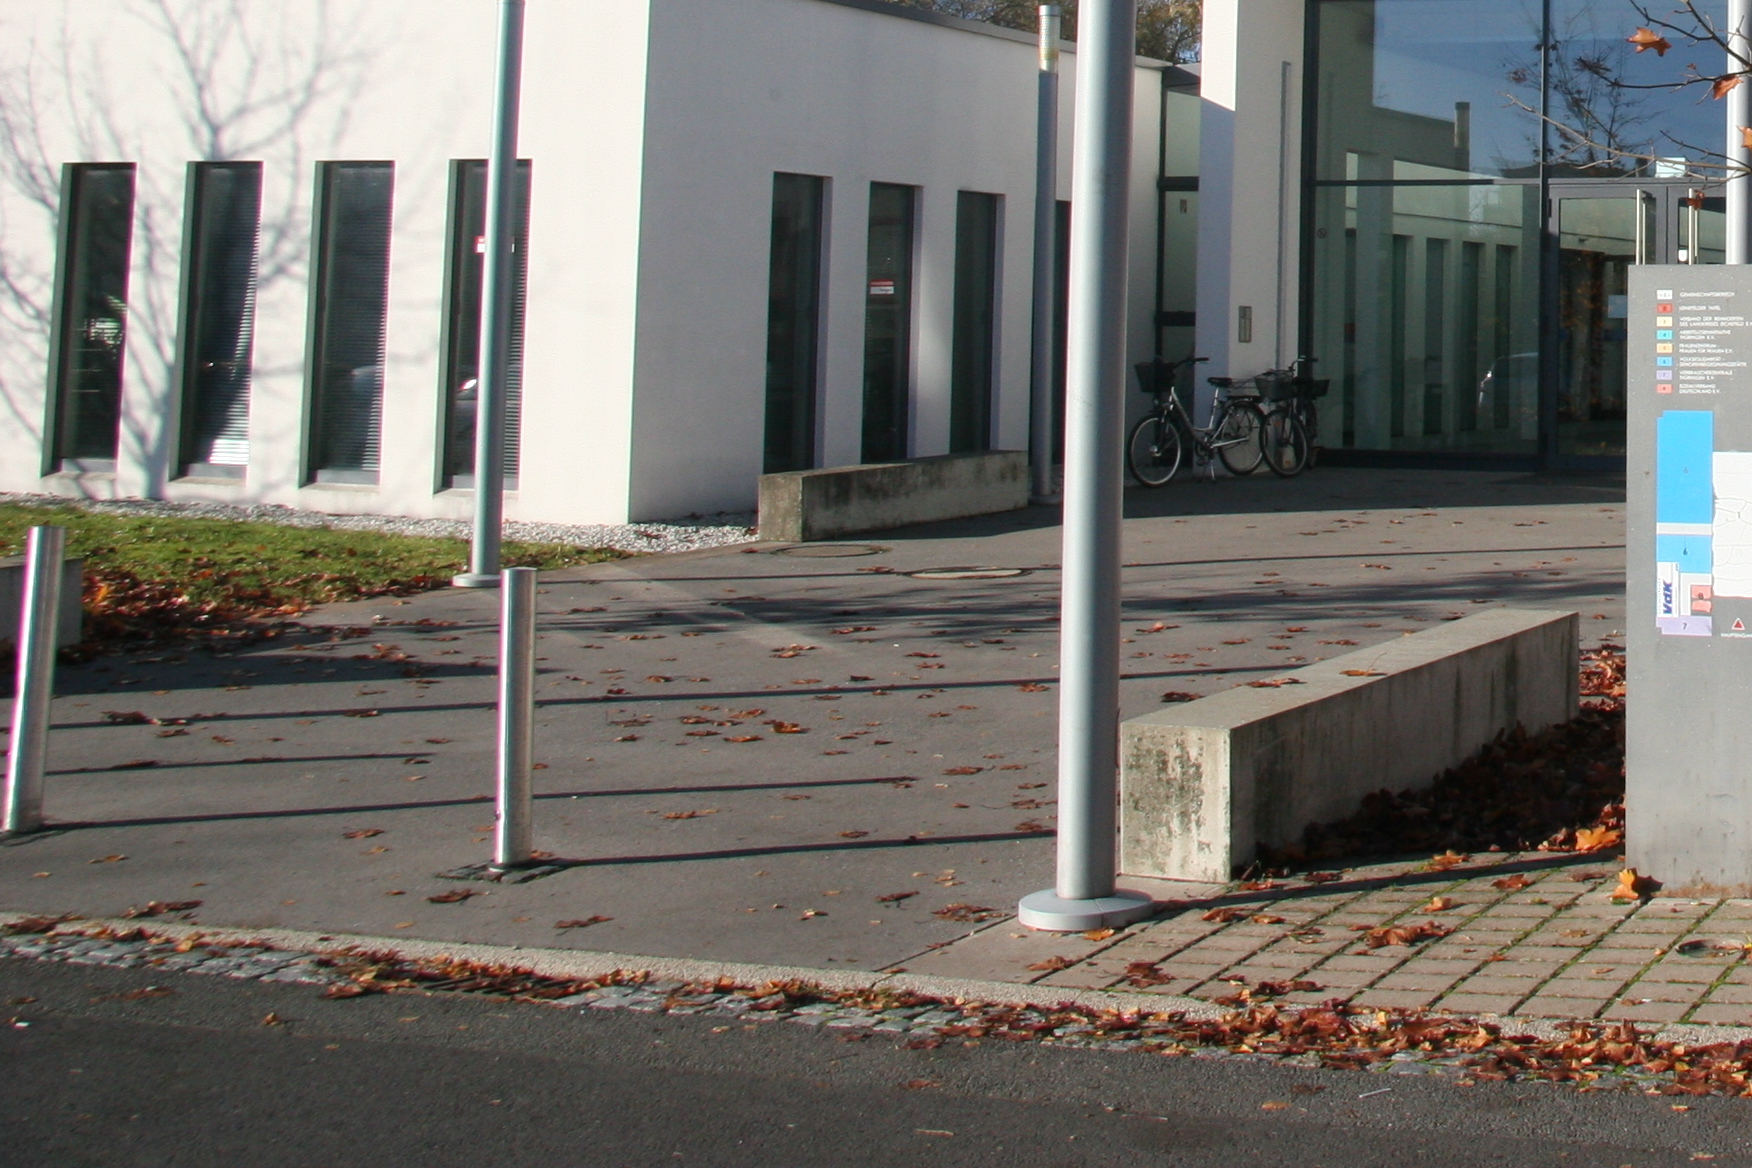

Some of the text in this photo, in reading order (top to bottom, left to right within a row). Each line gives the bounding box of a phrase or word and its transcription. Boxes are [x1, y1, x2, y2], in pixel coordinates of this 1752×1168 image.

[1682, 548, 1688, 556] 6
[1662, 578, 1673, 615] VdK
[1682, 622, 1688, 631] 7
